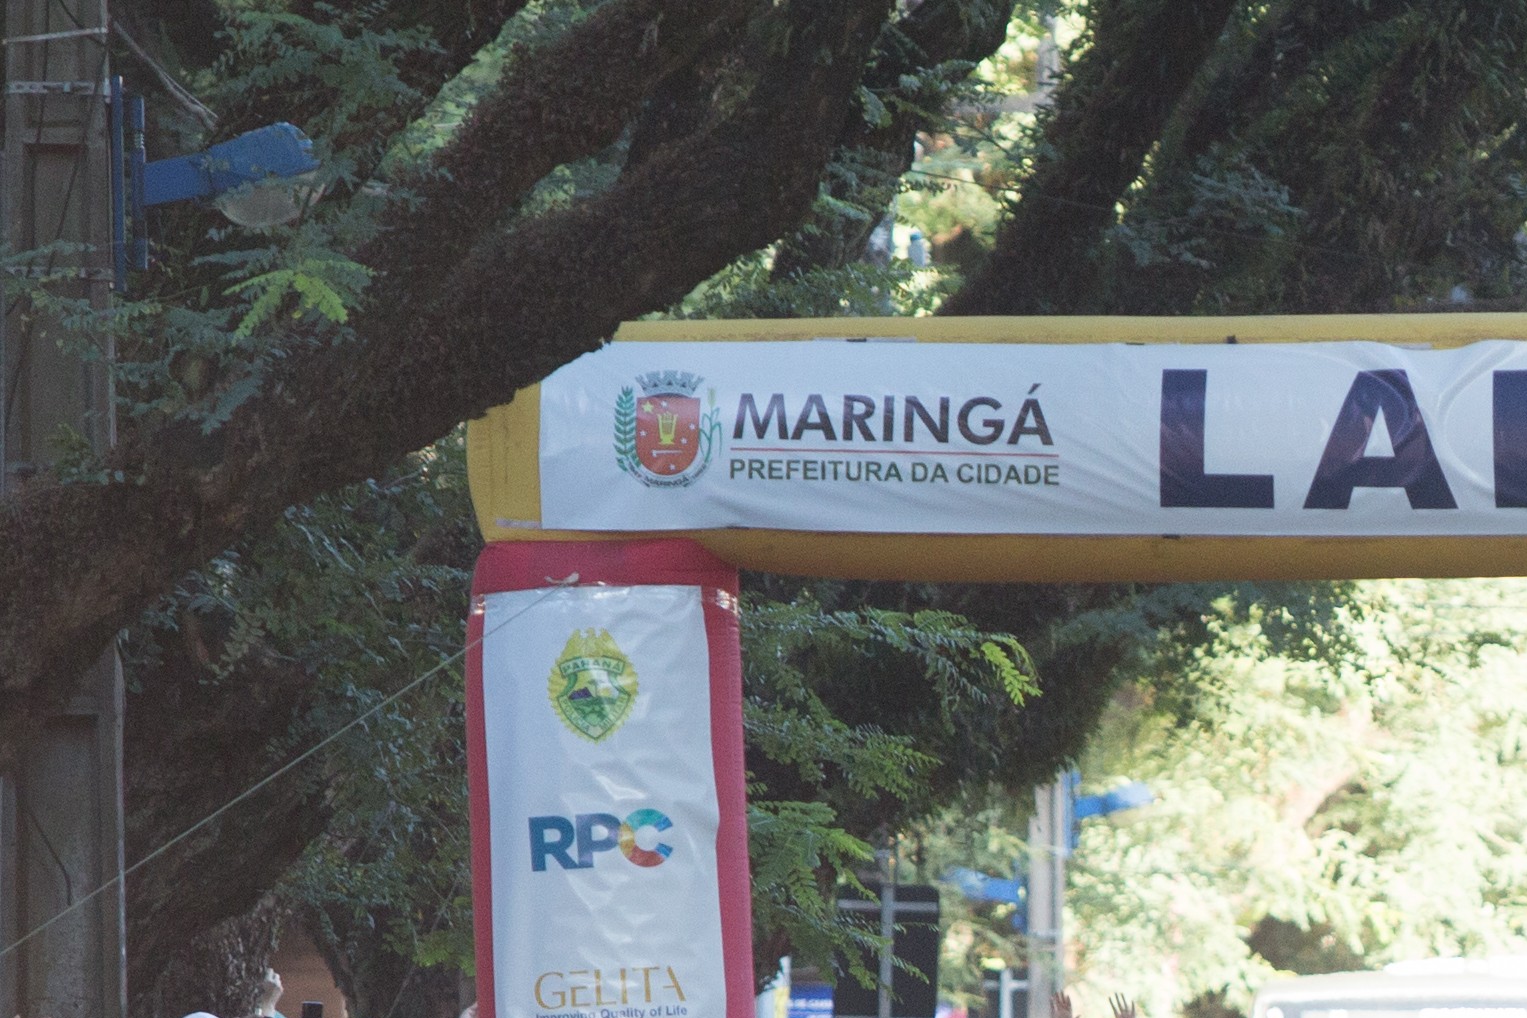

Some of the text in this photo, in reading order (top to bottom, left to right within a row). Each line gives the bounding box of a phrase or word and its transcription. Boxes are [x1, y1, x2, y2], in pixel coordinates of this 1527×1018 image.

[731, 382, 1055, 447] MARINGÁ
[729, 457, 902, 484] PREFEITURA
[908, 459, 951, 484] DA
[956, 461, 1061, 487] CIDADE
[527, 807, 674, 873] RPC
[533, 965, 687, 1011] GELITA
[649, 1005, 662, 1018] of
[665, 1004, 688, 1017] Life
